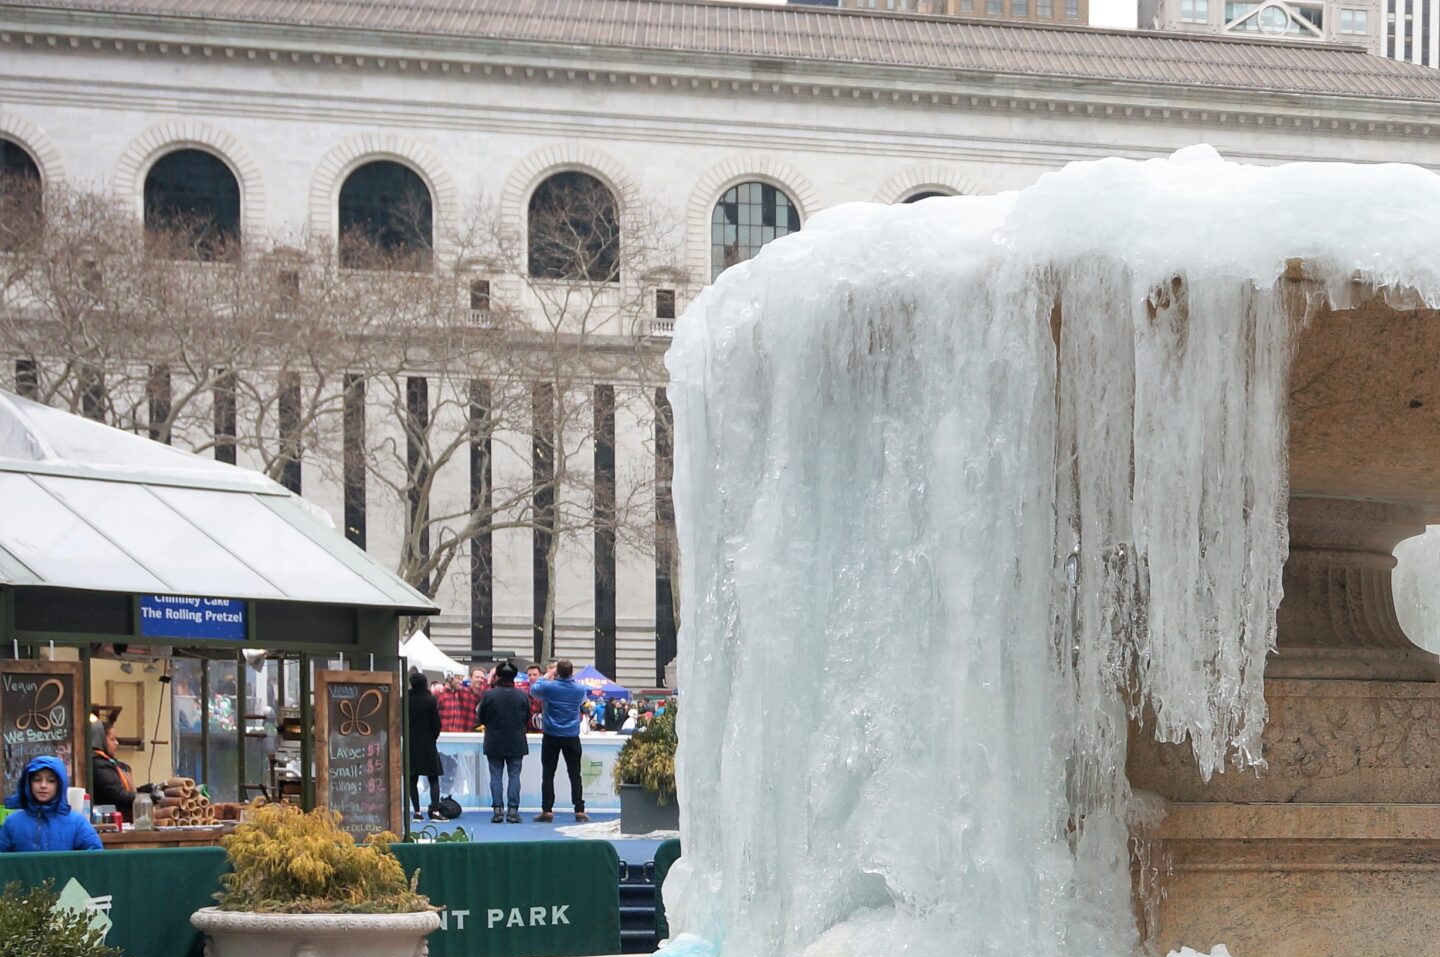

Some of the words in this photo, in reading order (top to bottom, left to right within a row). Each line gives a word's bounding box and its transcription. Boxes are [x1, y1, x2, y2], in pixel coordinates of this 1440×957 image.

[141, 606, 162, 619] The
[165, 607, 203, 623] Rolling
[205, 610, 243, 623] Pretzel
[3, 674, 38, 694] Vegan
[3, 729, 25, 744] We
[366, 743, 381, 757] $7
[365, 759, 384, 774] $5
[487, 904, 571, 929] PARK
